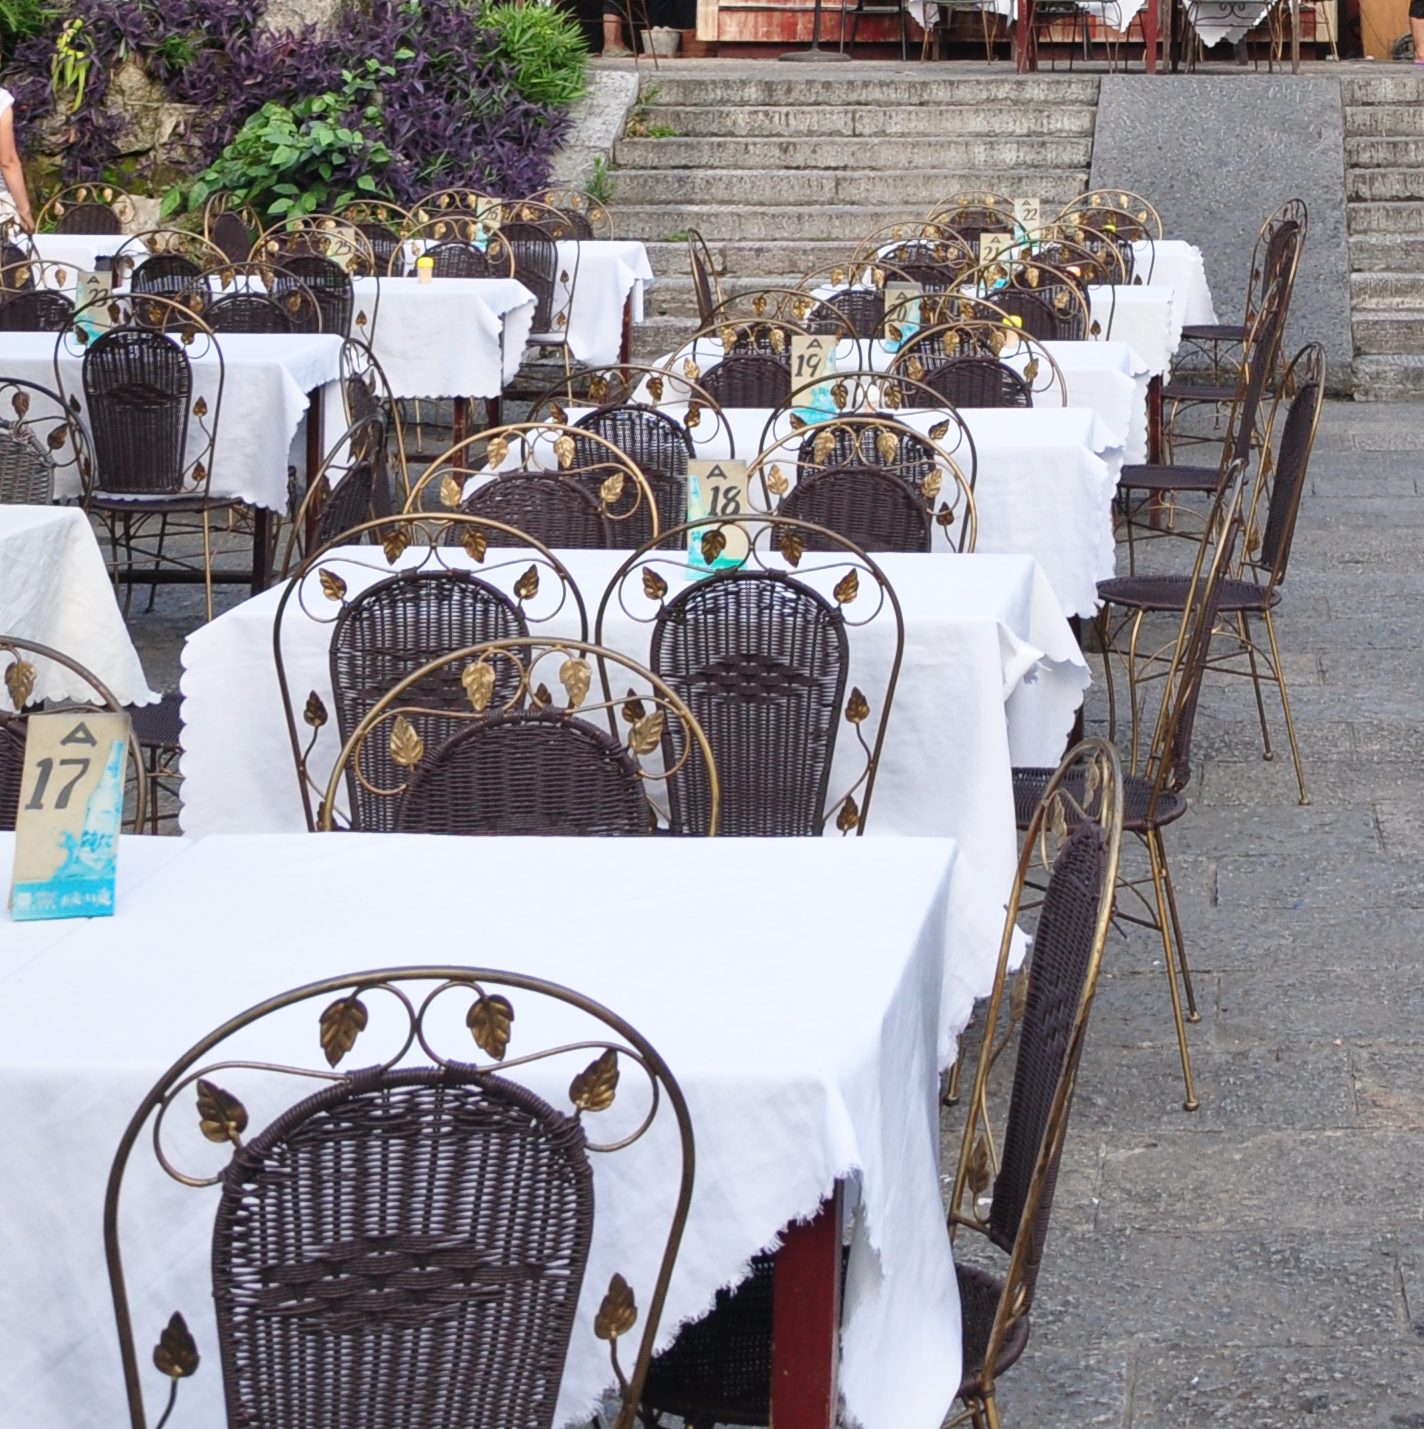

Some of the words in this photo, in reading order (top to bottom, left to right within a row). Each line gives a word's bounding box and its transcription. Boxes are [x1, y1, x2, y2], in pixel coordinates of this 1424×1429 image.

[1022, 208, 1038, 221] 22
[806, 337, 823, 350] A
[795, 353, 822, 379] 19
[706, 463, 728, 480] A
[708, 485, 742, 517] 18
[60, 721, 98, 748] A
[24, 757, 91, 811] 17
